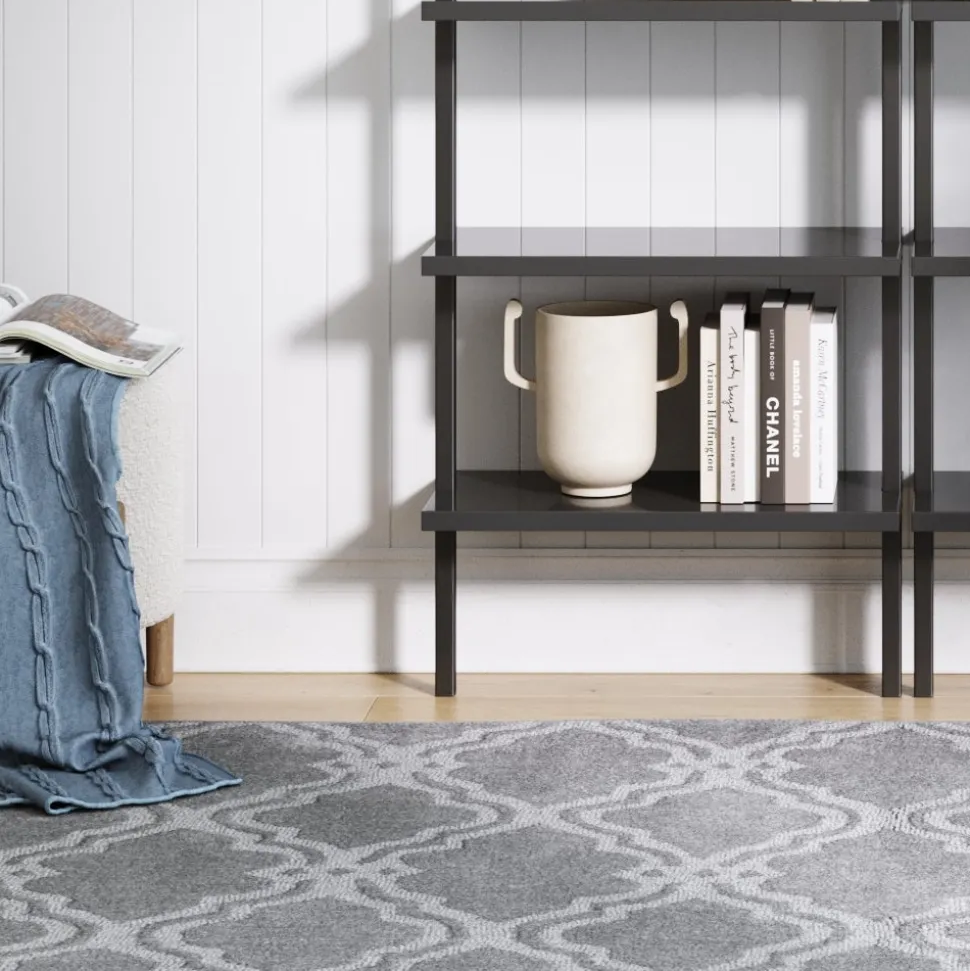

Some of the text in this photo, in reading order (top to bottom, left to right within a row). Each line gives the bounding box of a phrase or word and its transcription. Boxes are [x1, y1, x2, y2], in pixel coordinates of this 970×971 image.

[728, 326, 738, 353] The
[722, 385, 738, 424] beyond
[769, 371, 775, 381] OF
[705, 361, 716, 472] Arianna Huffington
[766, 396, 780, 478] CHANEL
[792, 360, 803, 459] amanda lovelace
